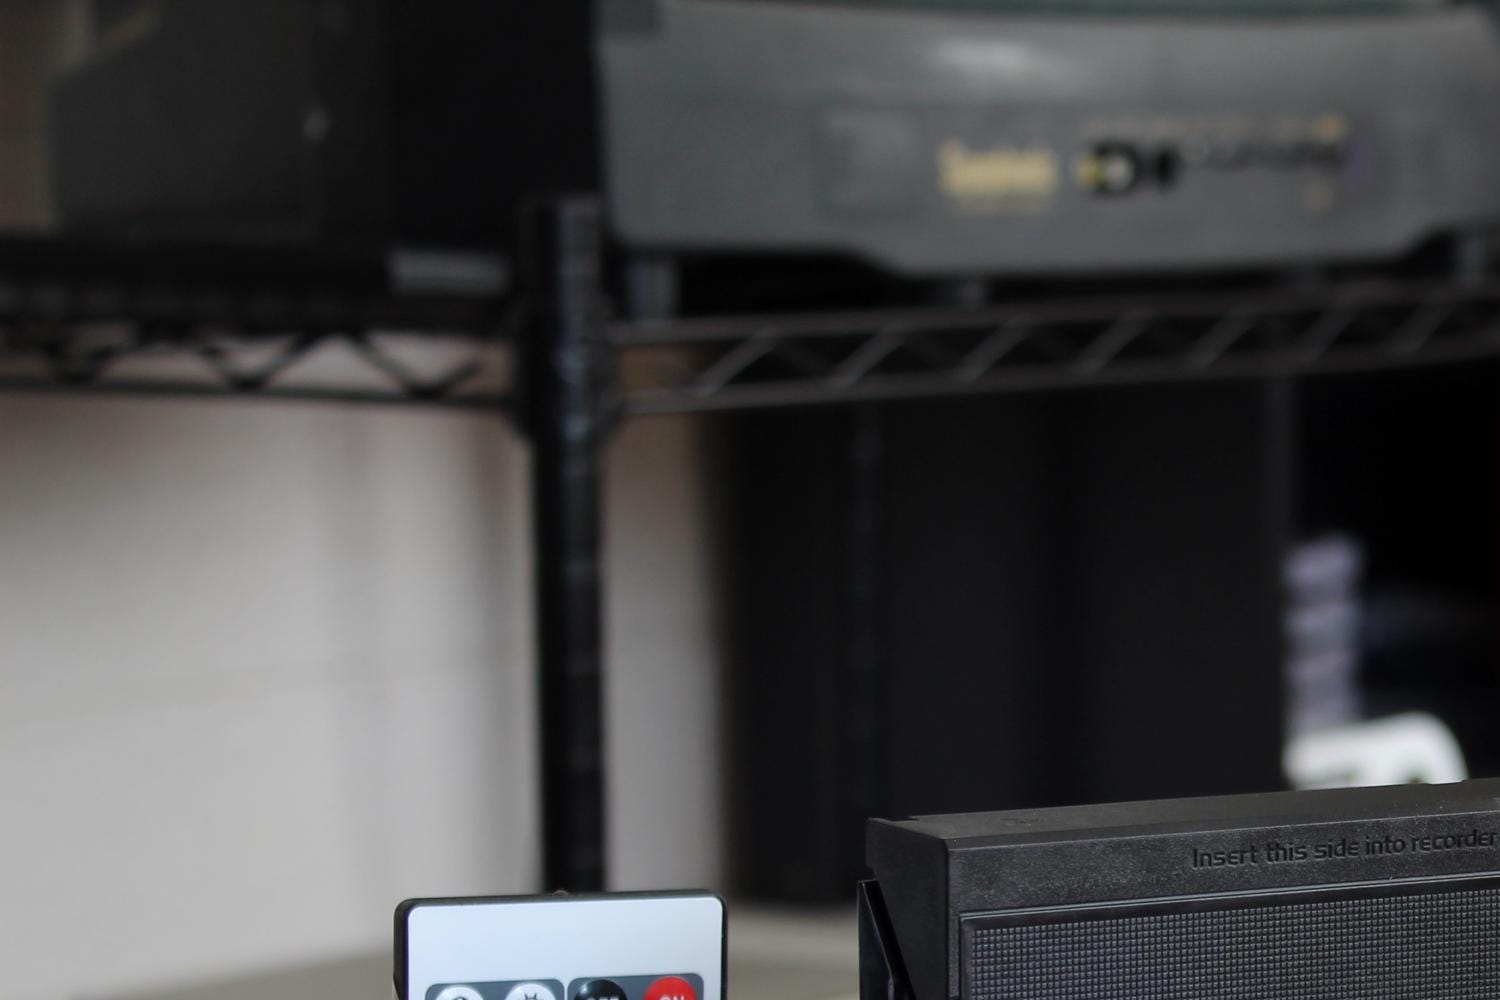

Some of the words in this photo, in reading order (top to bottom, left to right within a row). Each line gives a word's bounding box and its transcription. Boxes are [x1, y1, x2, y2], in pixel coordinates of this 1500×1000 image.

[1192, 845, 1258, 869] Insert
[1266, 842, 1307, 865] this
[1314, 838, 1358, 860] side
[1365, 835, 1406, 856] into
[1411, 829, 1498, 853] recorder
